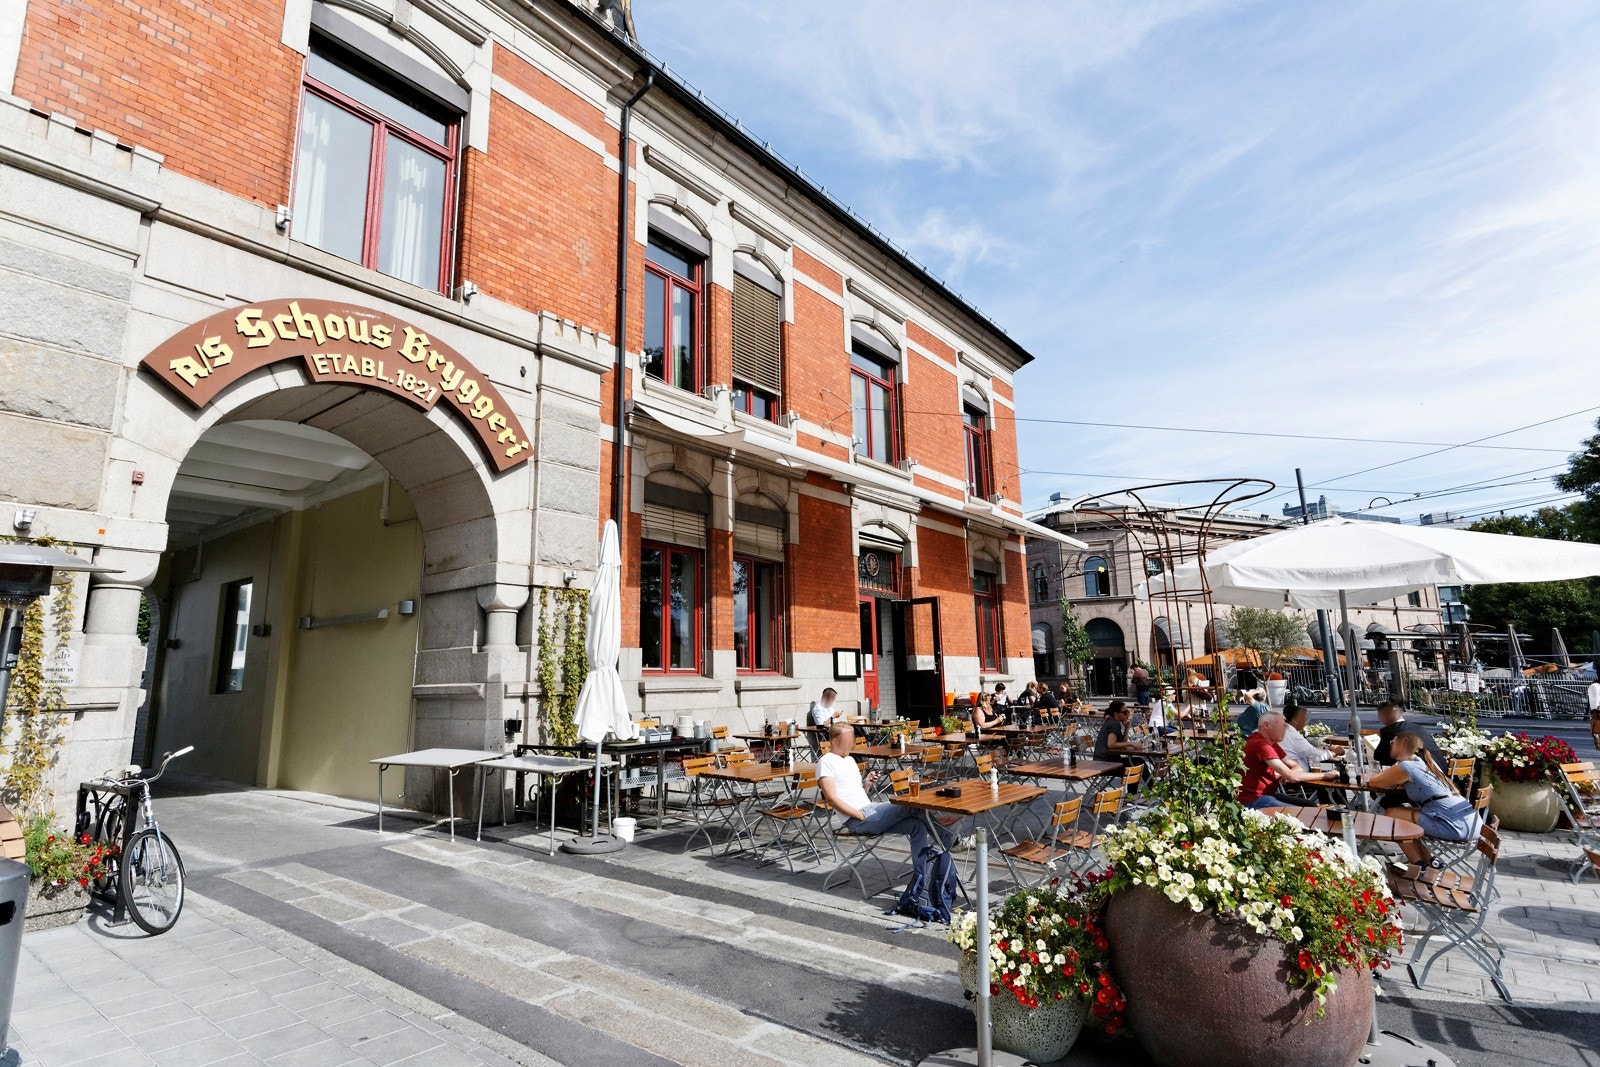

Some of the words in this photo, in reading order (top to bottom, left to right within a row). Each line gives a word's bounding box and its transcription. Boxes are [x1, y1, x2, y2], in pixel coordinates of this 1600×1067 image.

[169, 335, 234, 387] A/S
[236, 301, 396, 350] Schous
[397, 325, 529, 458] Bryggeri
